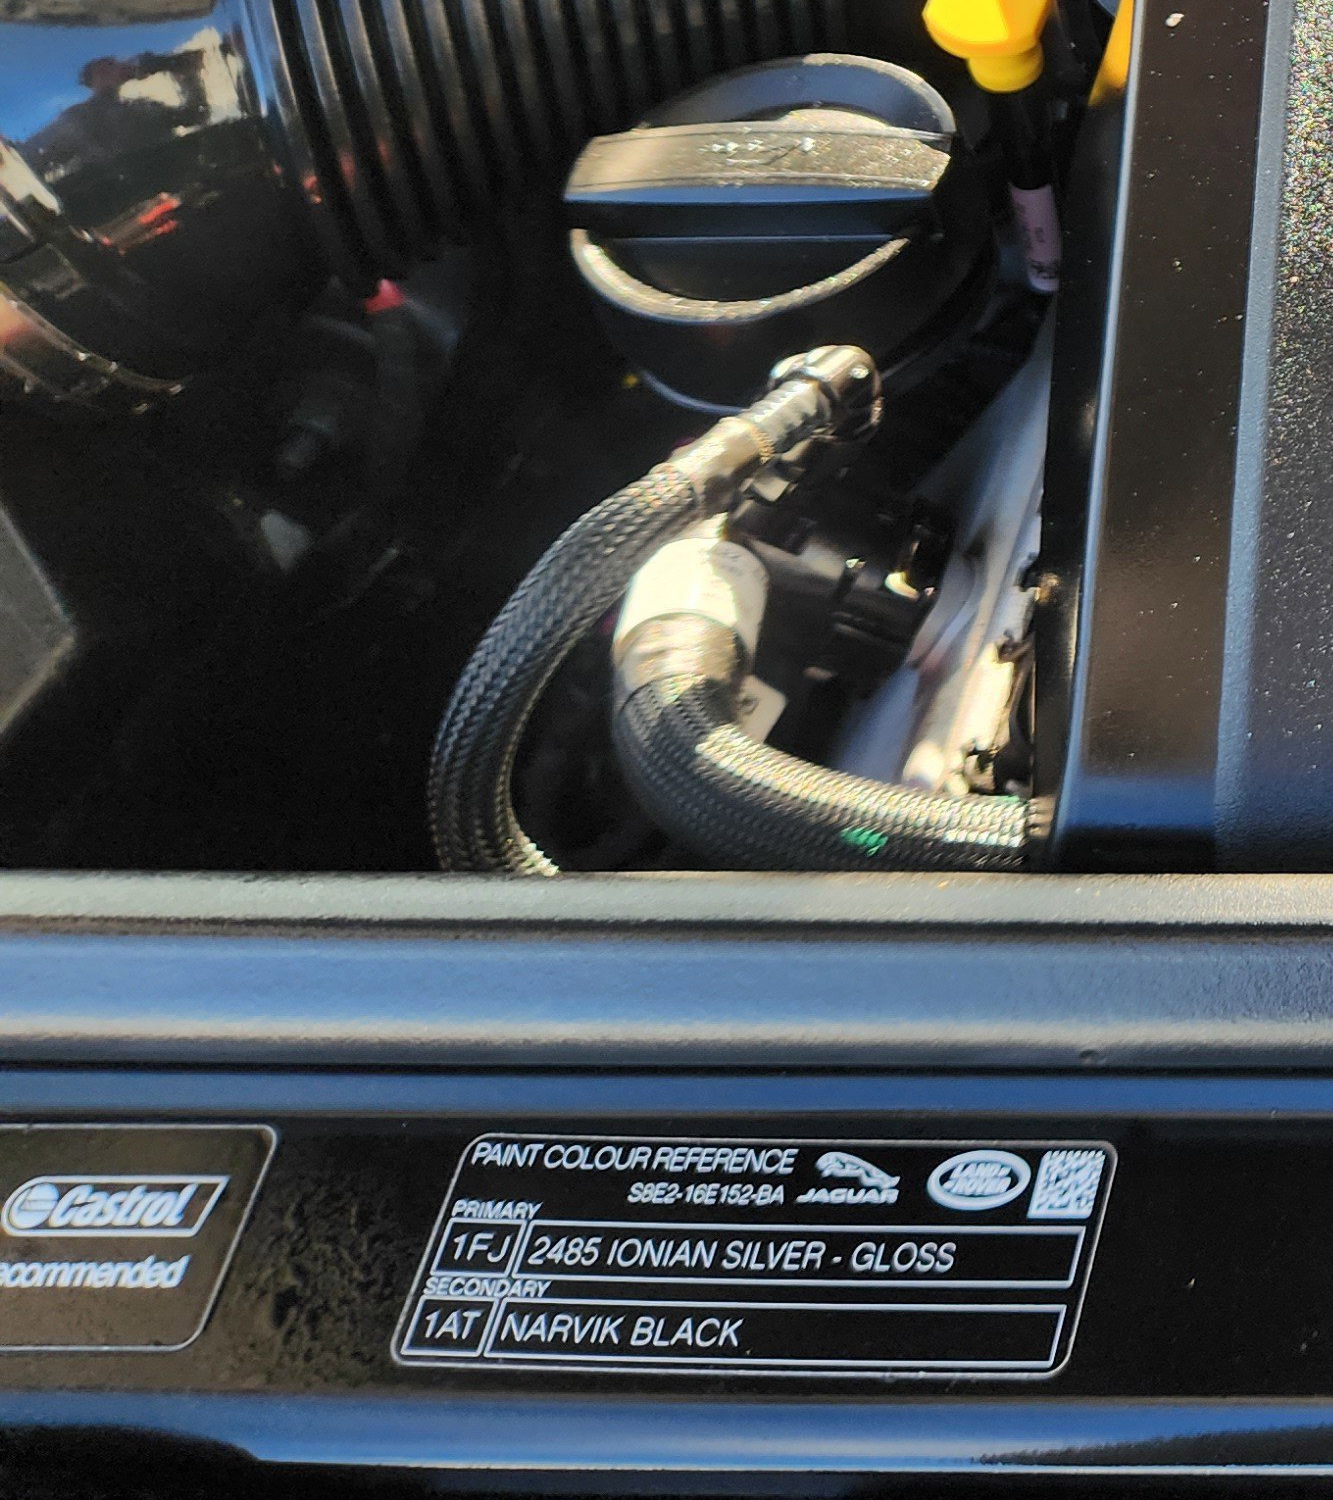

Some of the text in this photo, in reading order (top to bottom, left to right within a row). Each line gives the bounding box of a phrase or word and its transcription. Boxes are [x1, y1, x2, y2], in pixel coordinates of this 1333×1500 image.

[471, 1142, 799, 1174] PAINT COLOUR REFERENCE
[48, 1183, 199, 1227] Castrol
[628, 1182, 785, 1206] S8E2-16E152-BA
[794, 1187, 900, 1204] JAGUAR
[451, 1200, 542, 1220] PRIMARY
[452, 1233, 513, 1264] 1FJ
[527, 1235, 601, 1266] 2485
[606, 1238, 714, 1269] IONIAN
[718, 1240, 826, 1271] SILVER
[851, 1241, 957, 1273] GLOSS
[423, 1278, 552, 1299] SECONDARY
[424, 1310, 744, 1348] 1AT NARVIK BLACK
